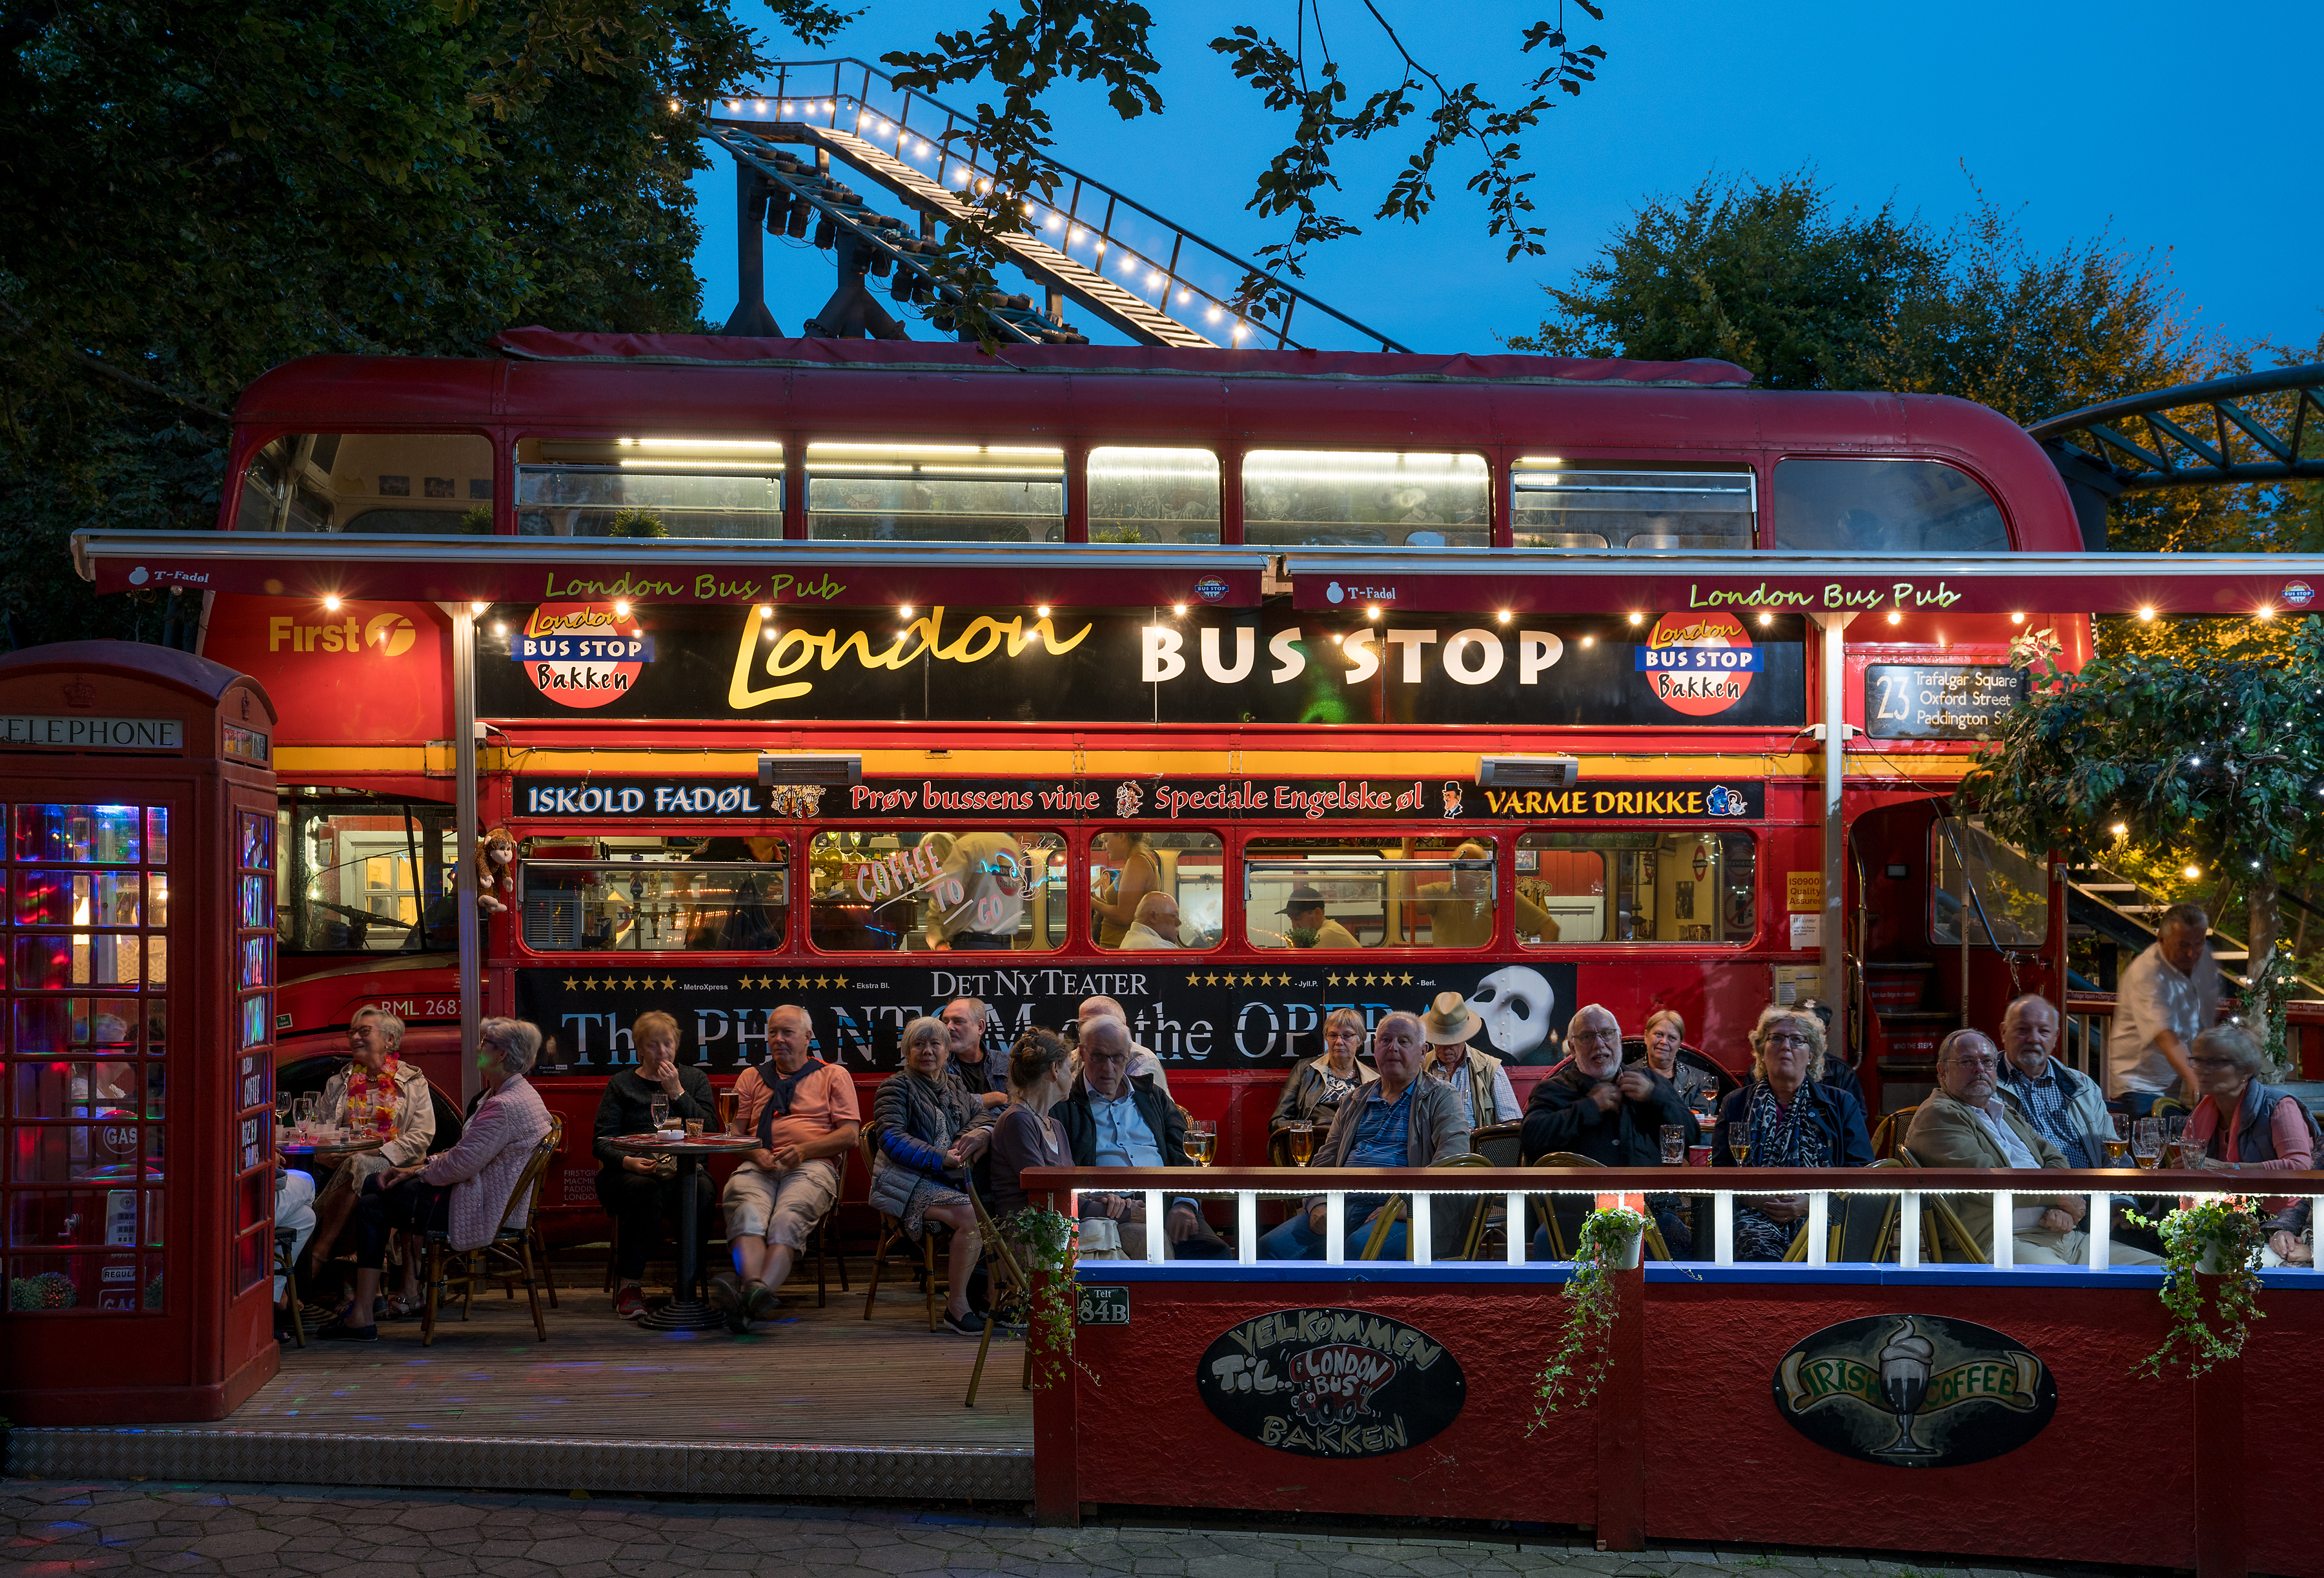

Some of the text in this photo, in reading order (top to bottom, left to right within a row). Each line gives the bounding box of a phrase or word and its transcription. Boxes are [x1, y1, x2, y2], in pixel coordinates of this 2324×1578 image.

[154, 571, 210, 583] T-Fadøl
[546, 572, 847, 600] London Bus Pub
[1348, 587, 1396, 600] T-Fadøl
[1690, 582, 1962, 609] London Bus Pub
[269, 617, 360, 652] First
[528, 608, 631, 639] London
[1650, 619, 1743, 650] London
[524, 640, 643, 657] BUS STOP
[728, 604, 1564, 710] London BUS STOP
[1646, 651, 1753, 668] BUS STOP
[538, 663, 629, 691] Bakken
[1658, 674, 1740, 699] Bakken
[1915, 671, 2017, 690] Trafalgar Square
[1877, 676, 1910, 720] 23
[1919, 691, 2011, 706] Oxford Street
[0, 719, 174, 746] ELEPHONE
[1917, 711, 1988, 730] Paddington
[528, 784, 761, 814] ISKOLD FADØL
[850, 781, 1100, 812] Prøv bussens vine
[1155, 781, 1424, 819] Speciale Engelske øl
[1484, 790, 1704, 815] VARME DRIKKE
[857, 843, 942, 903] COFFEE
[926, 879, 964, 912] TO
[1790, 888, 1820, 896] Quality
[978, 894, 1003, 926] GO
[1040, 970, 1149, 996] TEATER
[382, 1001, 420, 1016] RML
[562, 1012, 640, 1066] Th
[1135, 1003, 1214, 1060] the
[107, 1128, 137, 1145] GAS
[104, 1270, 136, 1279] REGULA
[1080, 1299, 1126, 1322] 84B
[1228, 1310, 1442, 1371] VELKOMMEN
[1305, 1347, 1391, 1384] LONDON
[1314, 1375, 1360, 1397] BUS
[1926, 1365, 2016, 1407] COFFEE
[1258, 1415, 1408, 1452] BAKKEN
